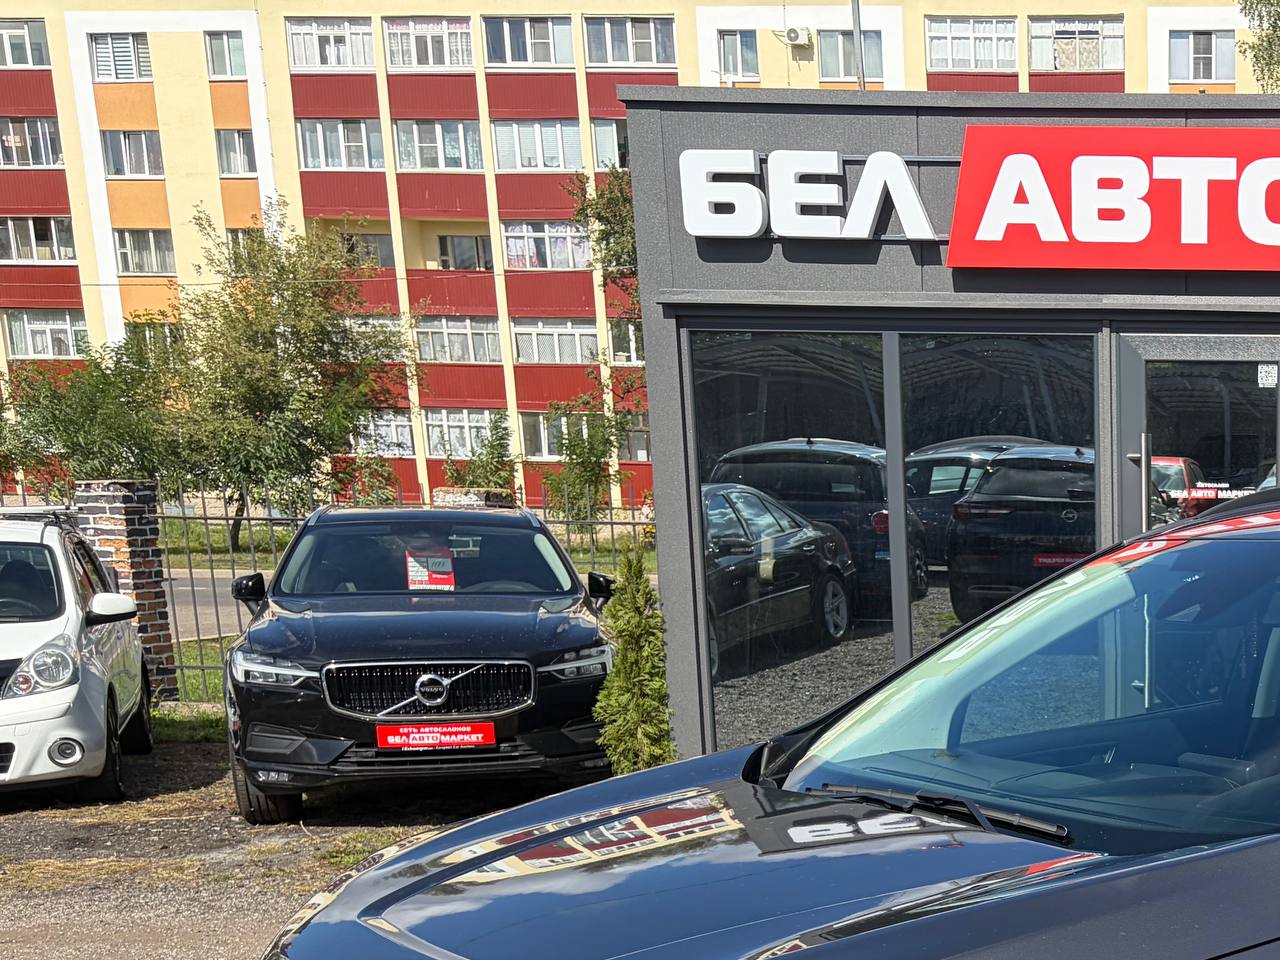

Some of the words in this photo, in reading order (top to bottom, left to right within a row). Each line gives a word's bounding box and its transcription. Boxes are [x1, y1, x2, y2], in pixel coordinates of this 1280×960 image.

[678, 148, 938, 241] БЕЛ
[411, 735, 440, 743] АВТО
[440, 733, 484, 743] МАРКЕТ
